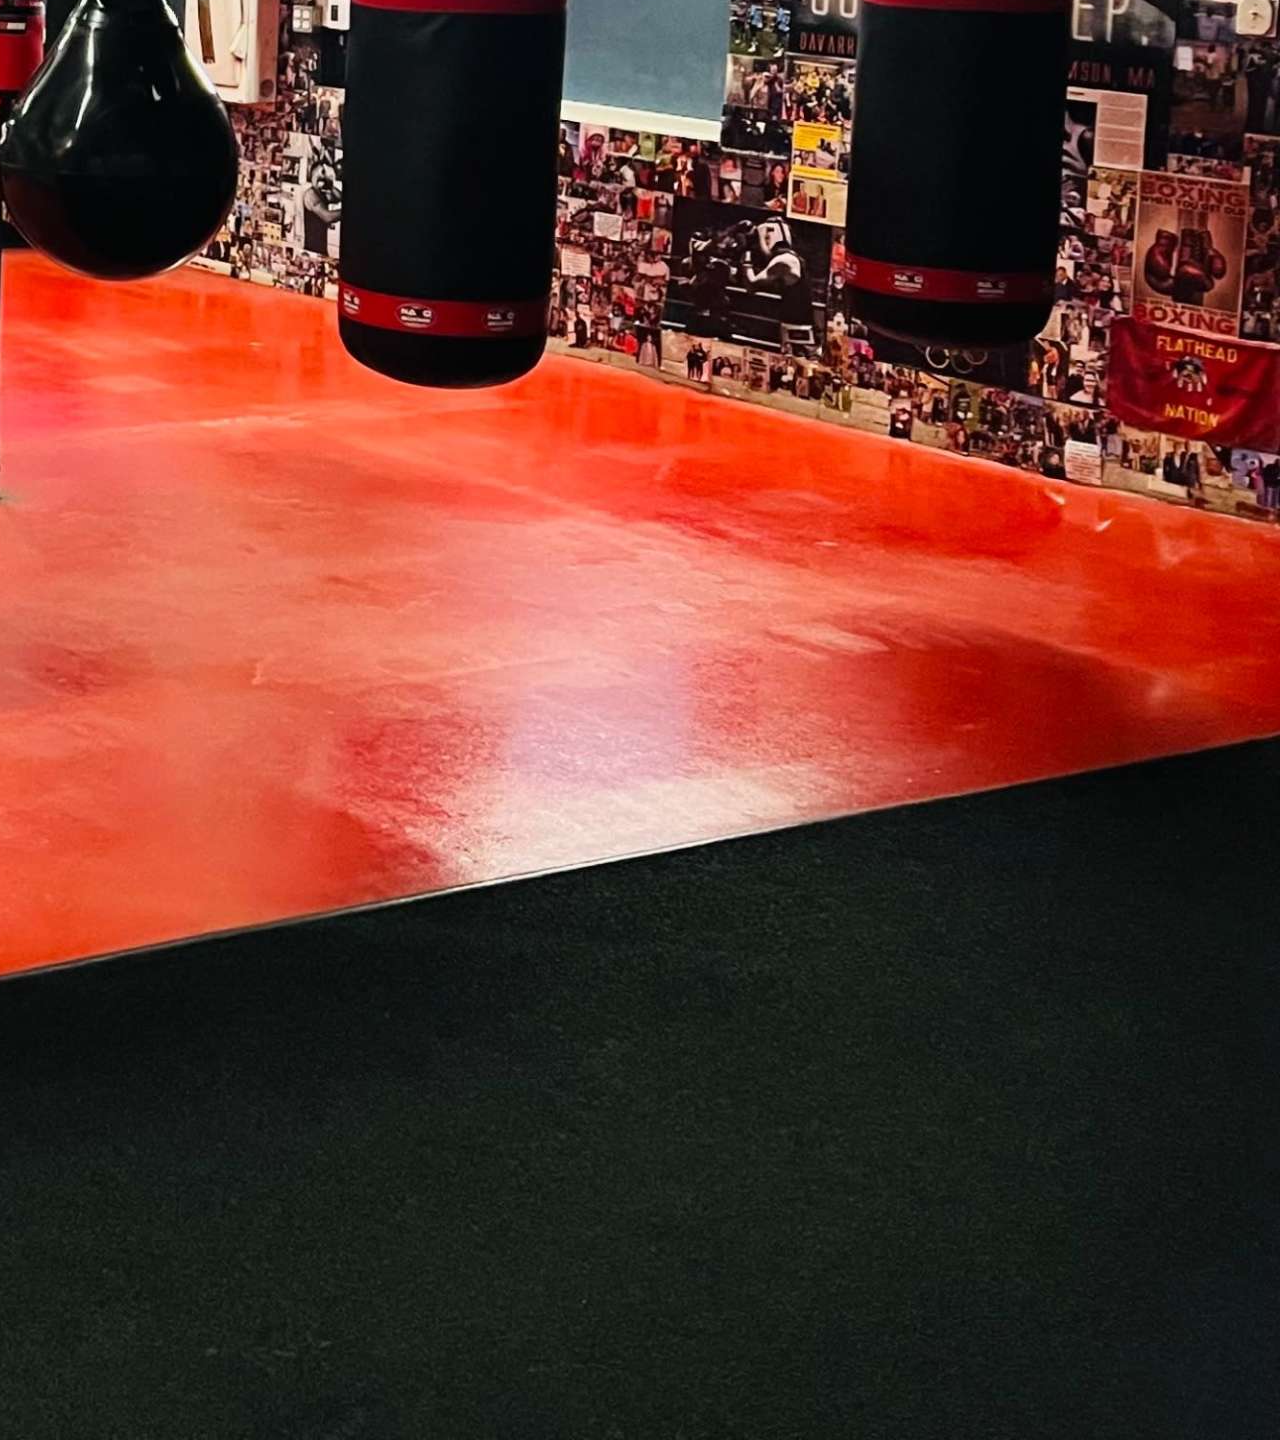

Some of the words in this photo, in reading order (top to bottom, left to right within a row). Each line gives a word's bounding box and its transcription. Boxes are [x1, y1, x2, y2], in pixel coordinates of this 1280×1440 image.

[1140, 180, 1246, 207] BOXING
[1141, 195, 1173, 206] WHEN
[1176, 199, 1198, 210] YOU
[1133, 303, 1234, 334] BOXING
[1156, 335, 1238, 364] FLATHEAD
[1164, 402, 1221, 428] NATION
